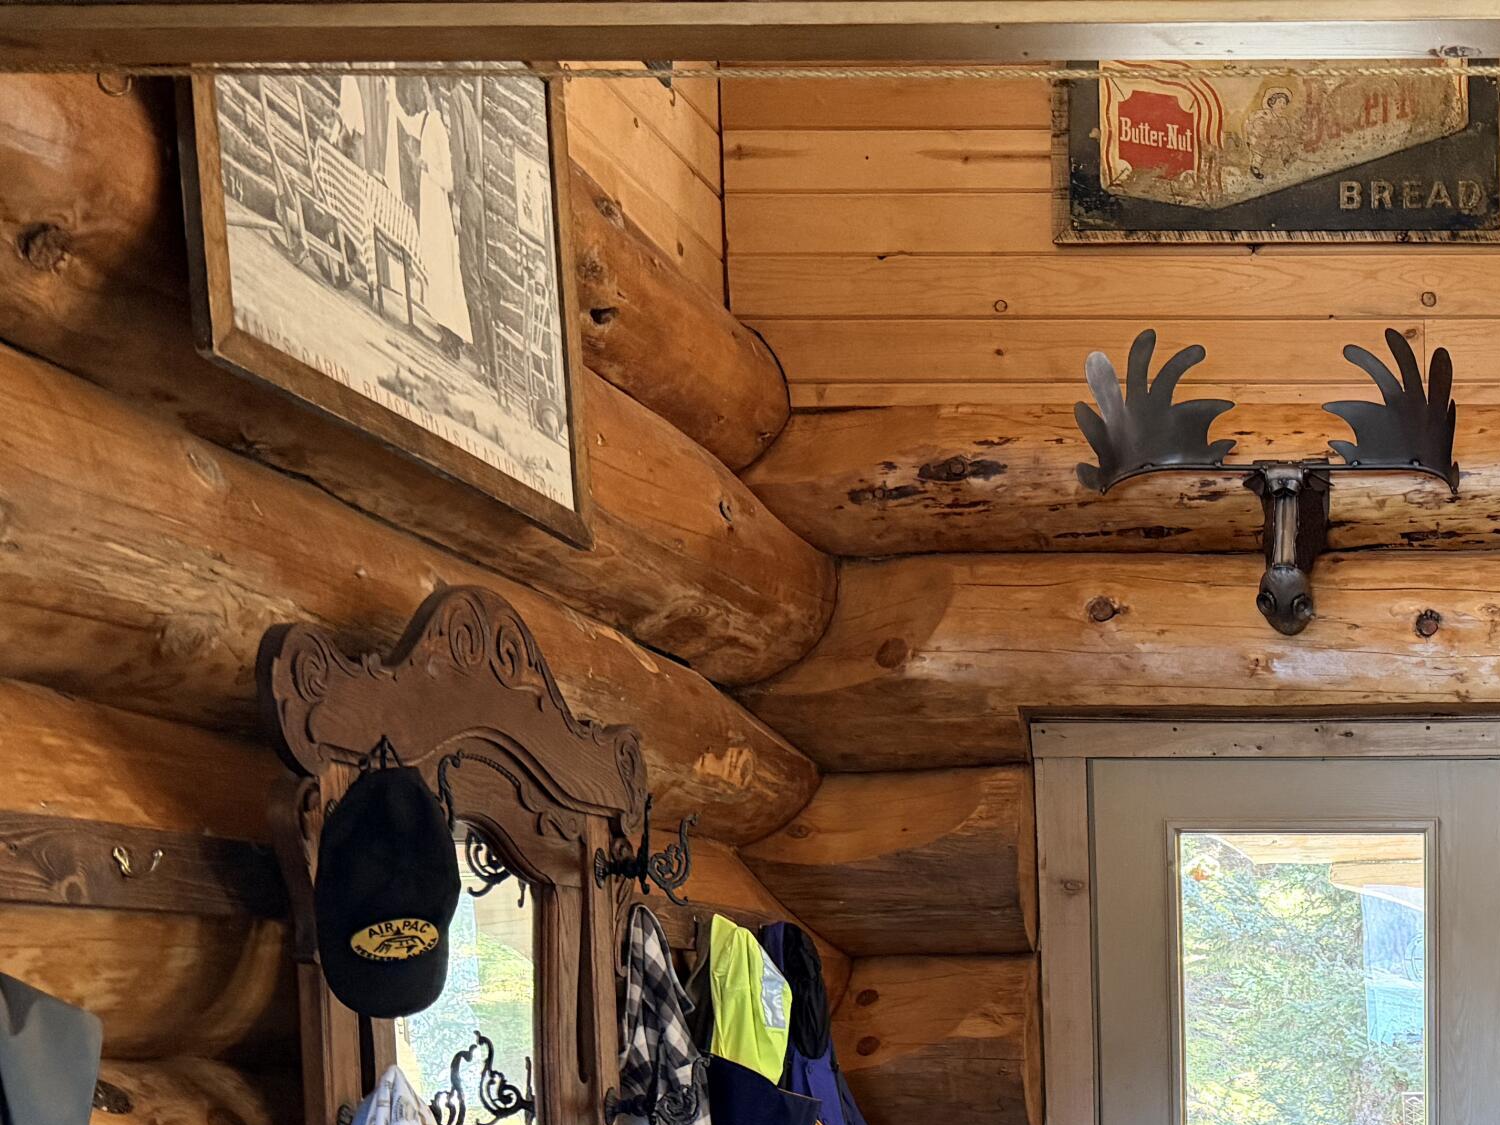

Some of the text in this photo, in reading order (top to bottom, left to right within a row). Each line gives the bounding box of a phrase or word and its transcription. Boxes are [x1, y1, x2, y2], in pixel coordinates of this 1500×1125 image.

[1119, 116, 1193, 153] Butter-Nut
[1339, 178, 1484, 213] BREAD
[368, 920, 431, 939] AIR PAC
